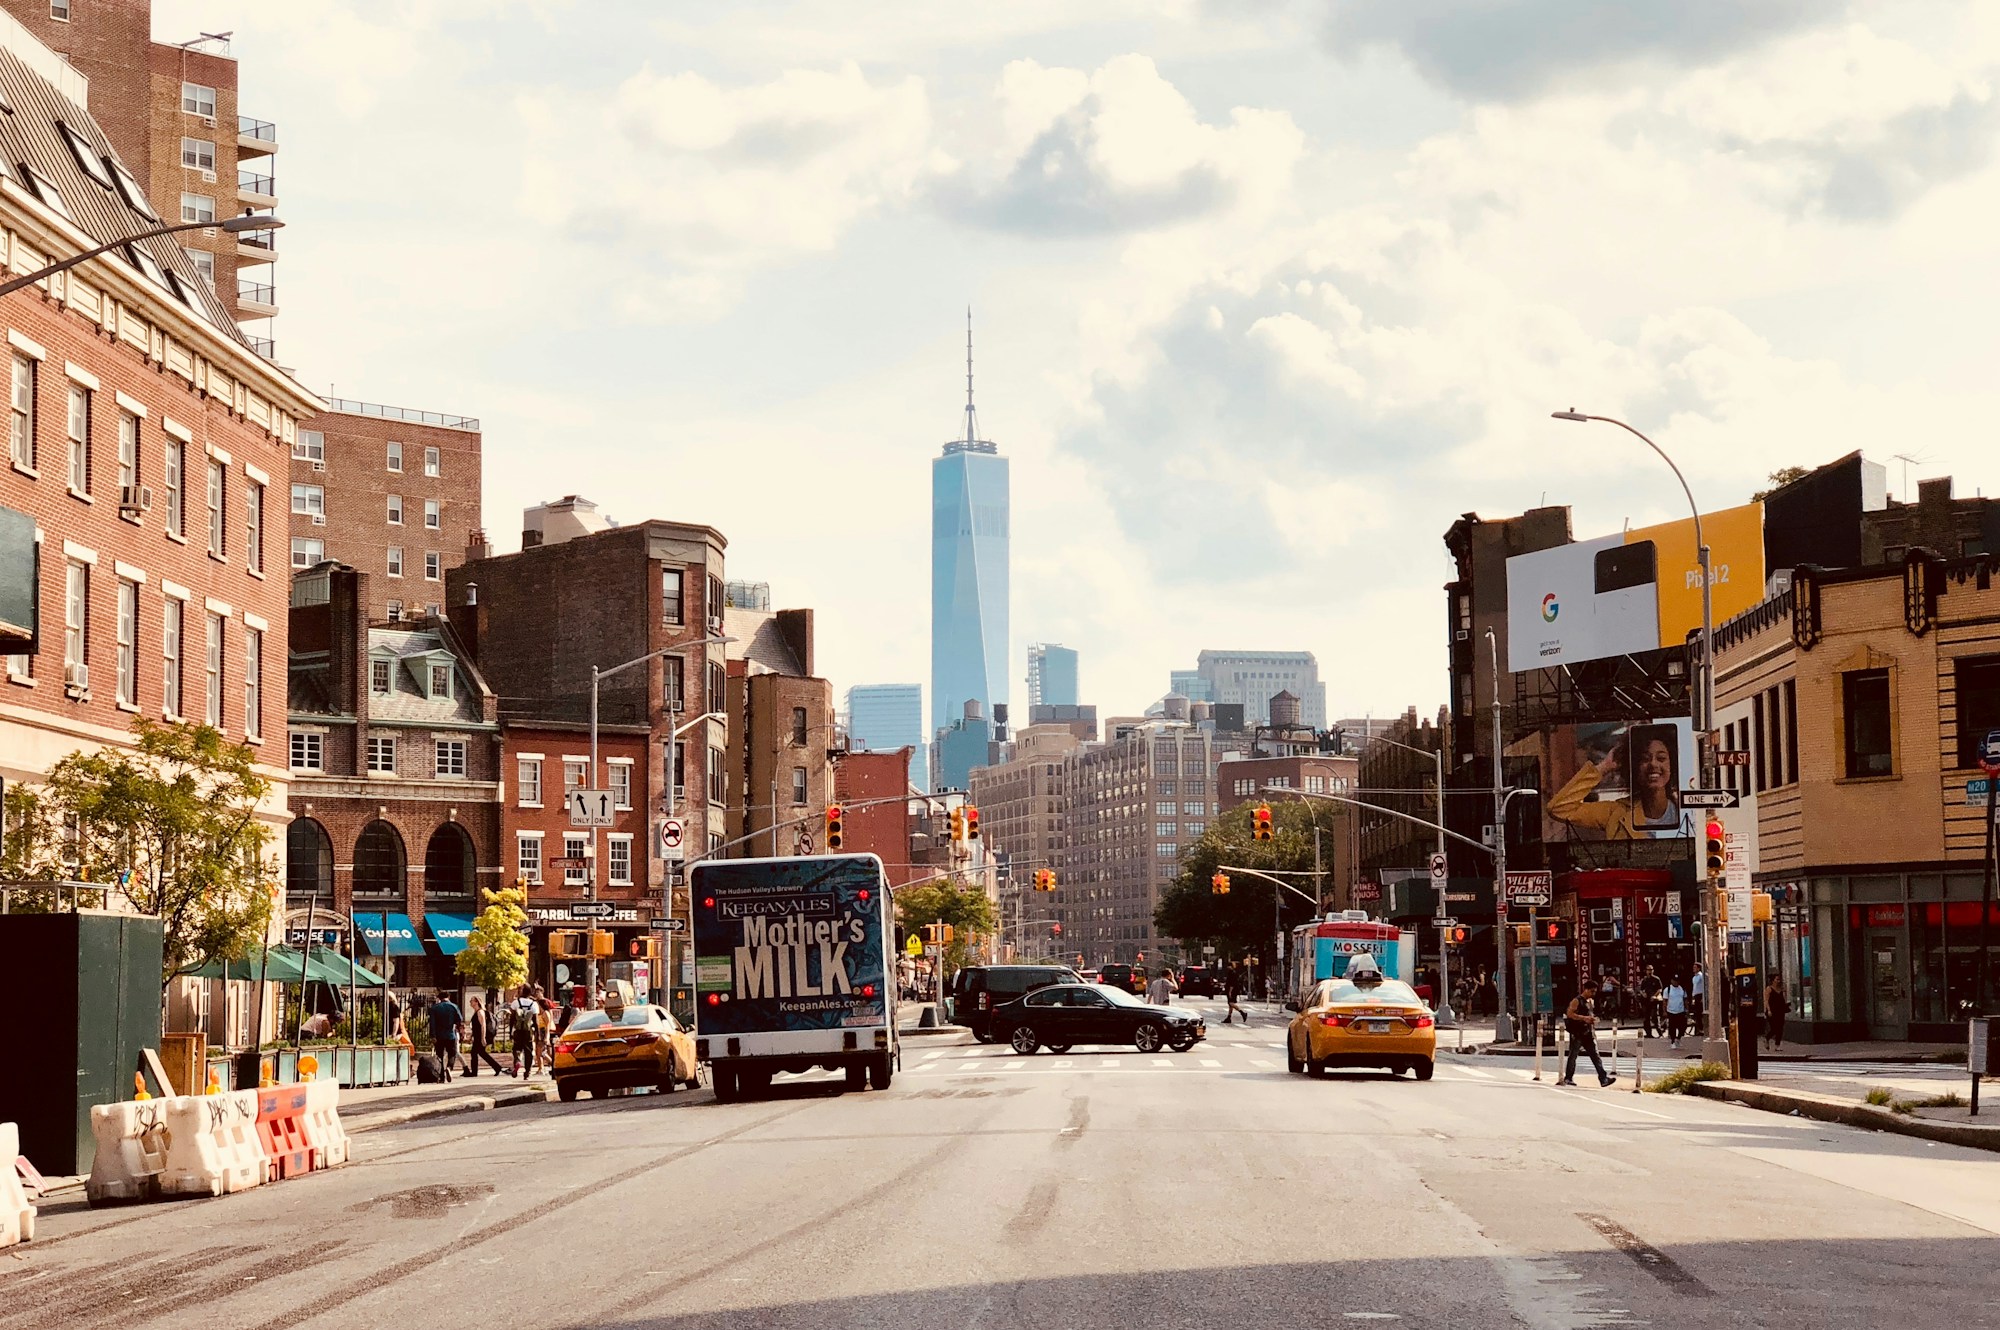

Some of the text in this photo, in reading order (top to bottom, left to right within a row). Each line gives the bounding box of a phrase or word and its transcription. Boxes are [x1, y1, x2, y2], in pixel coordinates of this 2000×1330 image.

[1720, 564, 1729, 583] 2
[1539, 647, 1561, 656] verizon
[1717, 753, 1748, 765] W 4 ST
[1688, 795, 1730, 803] ONE WAY
[722, 898, 830, 917] KEEGAN ALES
[1669, 903, 1679, 912] 20
[743, 911, 865, 947] Mother's
[734, 941, 852, 1000] MILK
[1742, 976, 1750, 987] P
